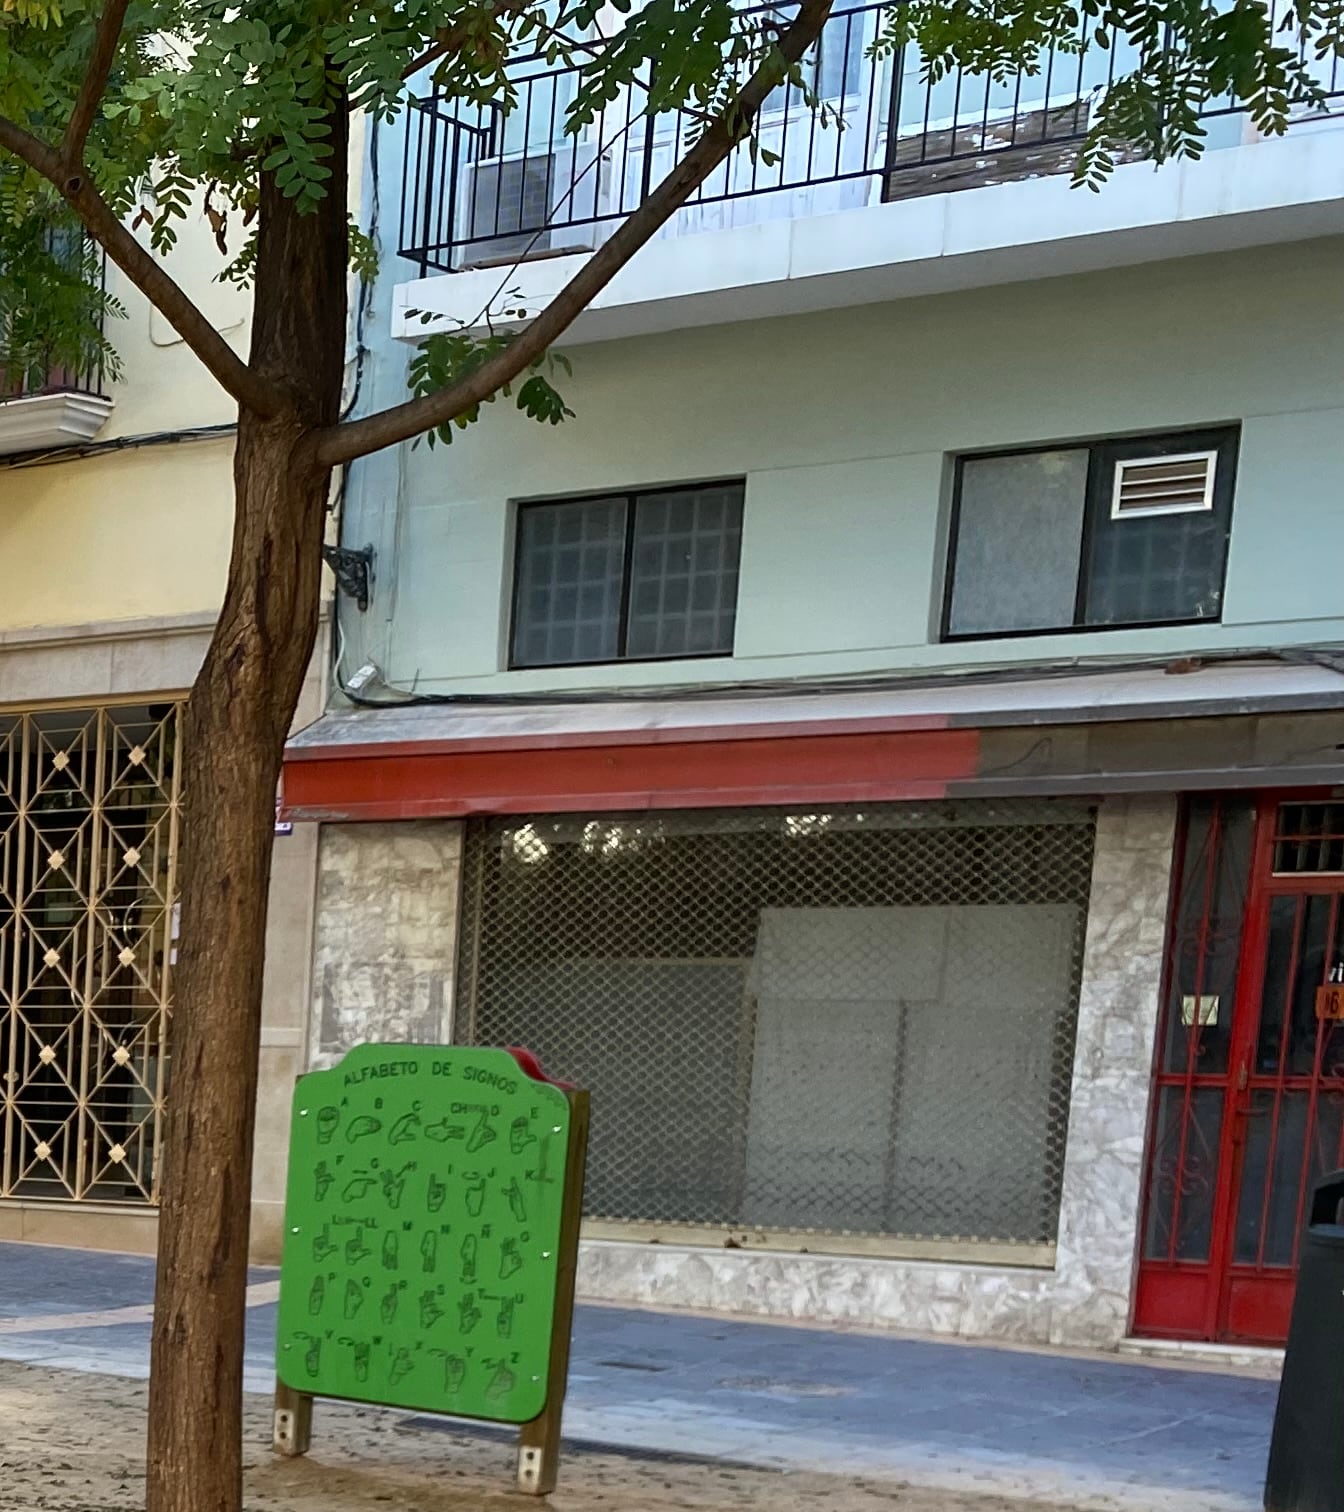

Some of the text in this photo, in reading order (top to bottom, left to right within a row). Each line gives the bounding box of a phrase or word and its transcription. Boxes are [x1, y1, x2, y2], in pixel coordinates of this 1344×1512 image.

[344, 1061, 518, 1095] ALFABETO DE SIGNOS
[412, 1100, 423, 1111] C
[530, 1107, 539, 1119] E
